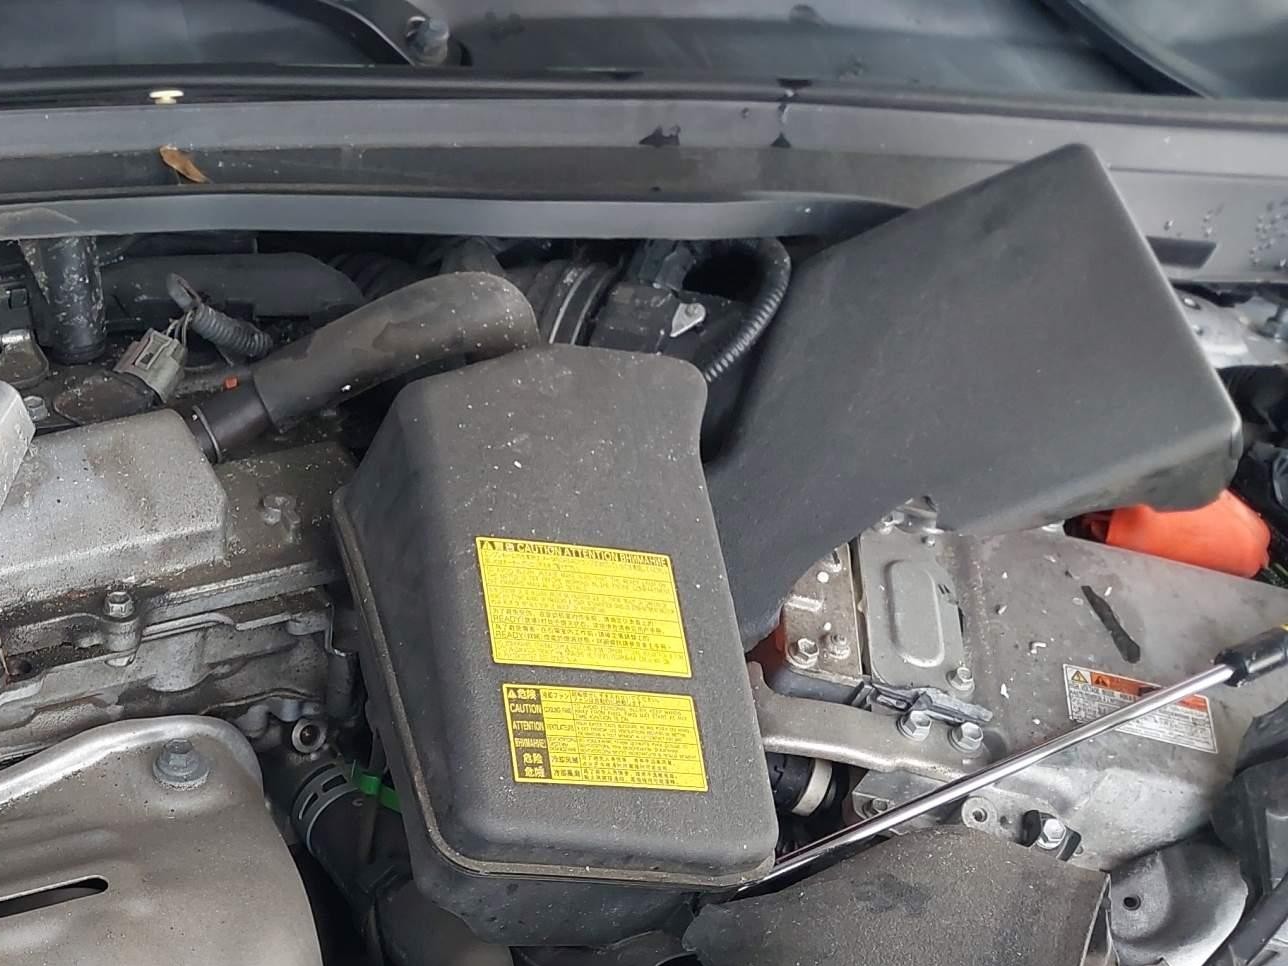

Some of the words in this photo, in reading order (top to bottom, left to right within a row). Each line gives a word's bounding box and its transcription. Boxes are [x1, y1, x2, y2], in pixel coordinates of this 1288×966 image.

[517, 543, 561, 556] CAUTION
[564, 547, 617, 561] ATTENTION
[510, 703, 542, 714] CAUTION
[512, 720, 544, 731] ATTENTION
